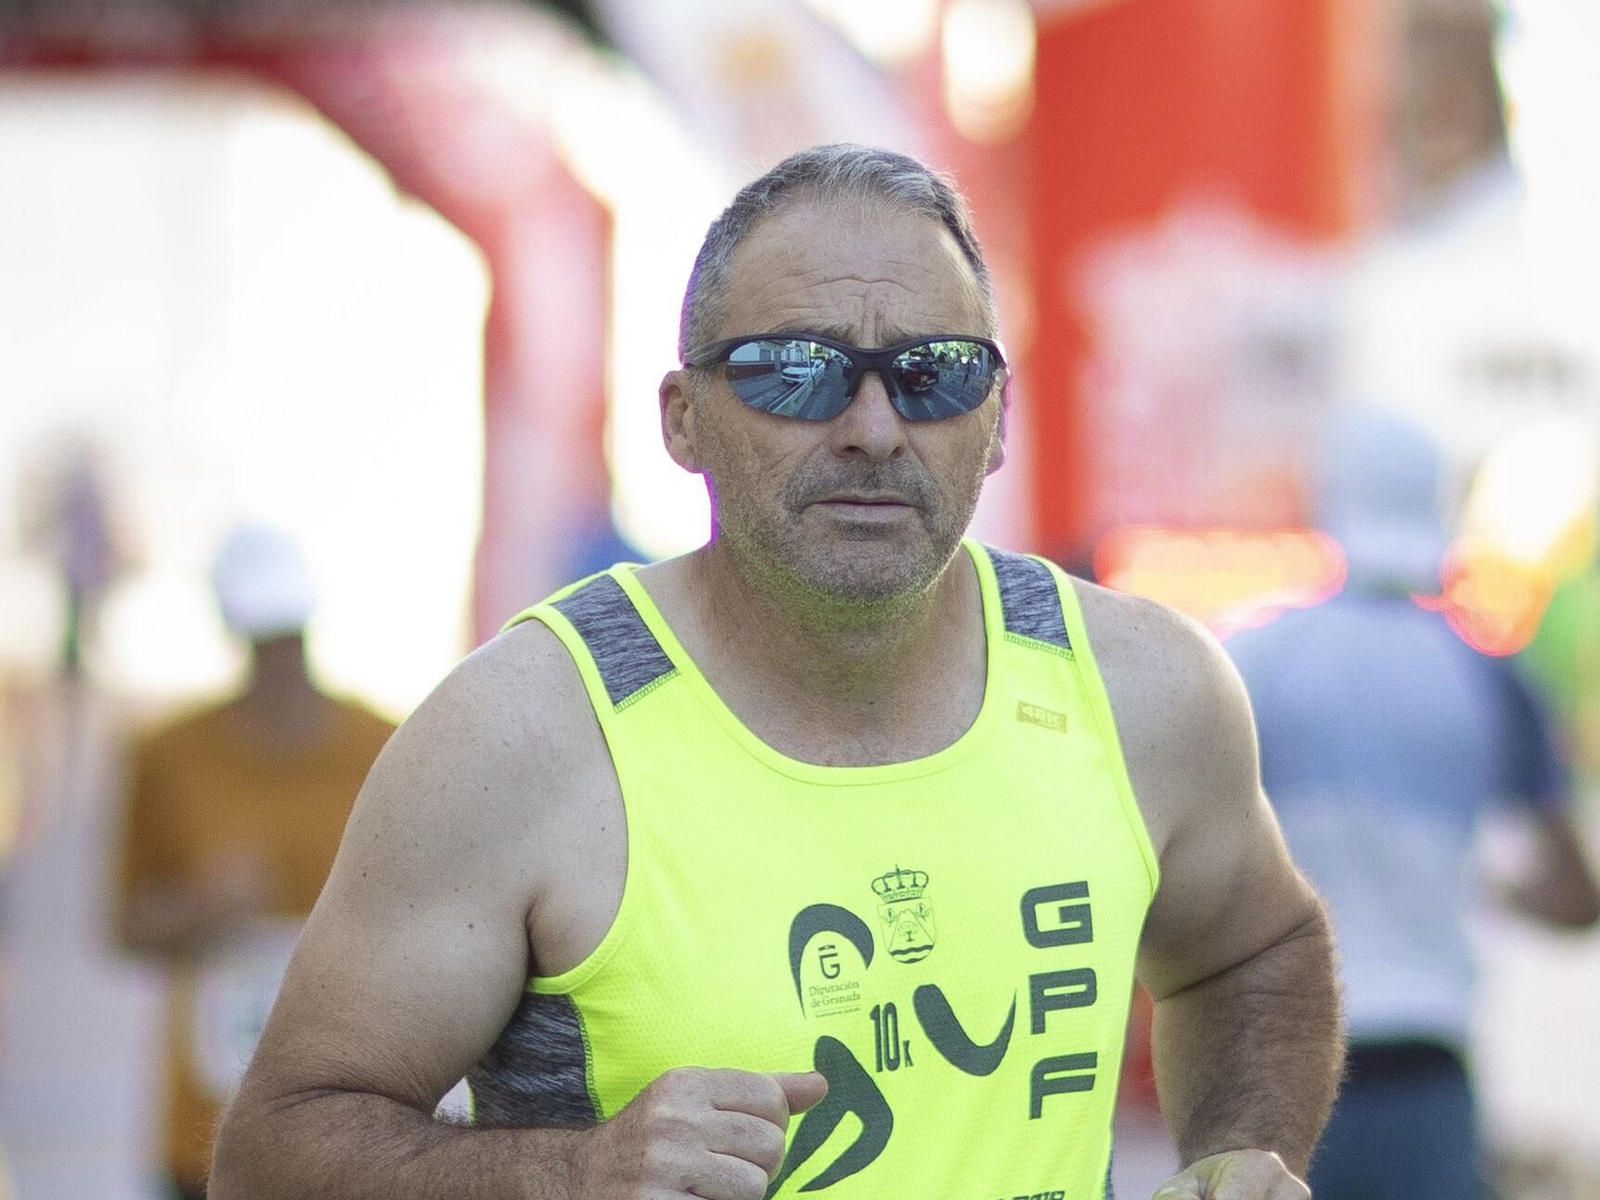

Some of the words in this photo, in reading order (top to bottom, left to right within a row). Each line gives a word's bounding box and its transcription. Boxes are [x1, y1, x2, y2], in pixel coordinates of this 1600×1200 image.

[808, 980, 860, 997] Diputación
[811, 998, 821, 1008] de
[821, 992, 862, 1006] Granada
